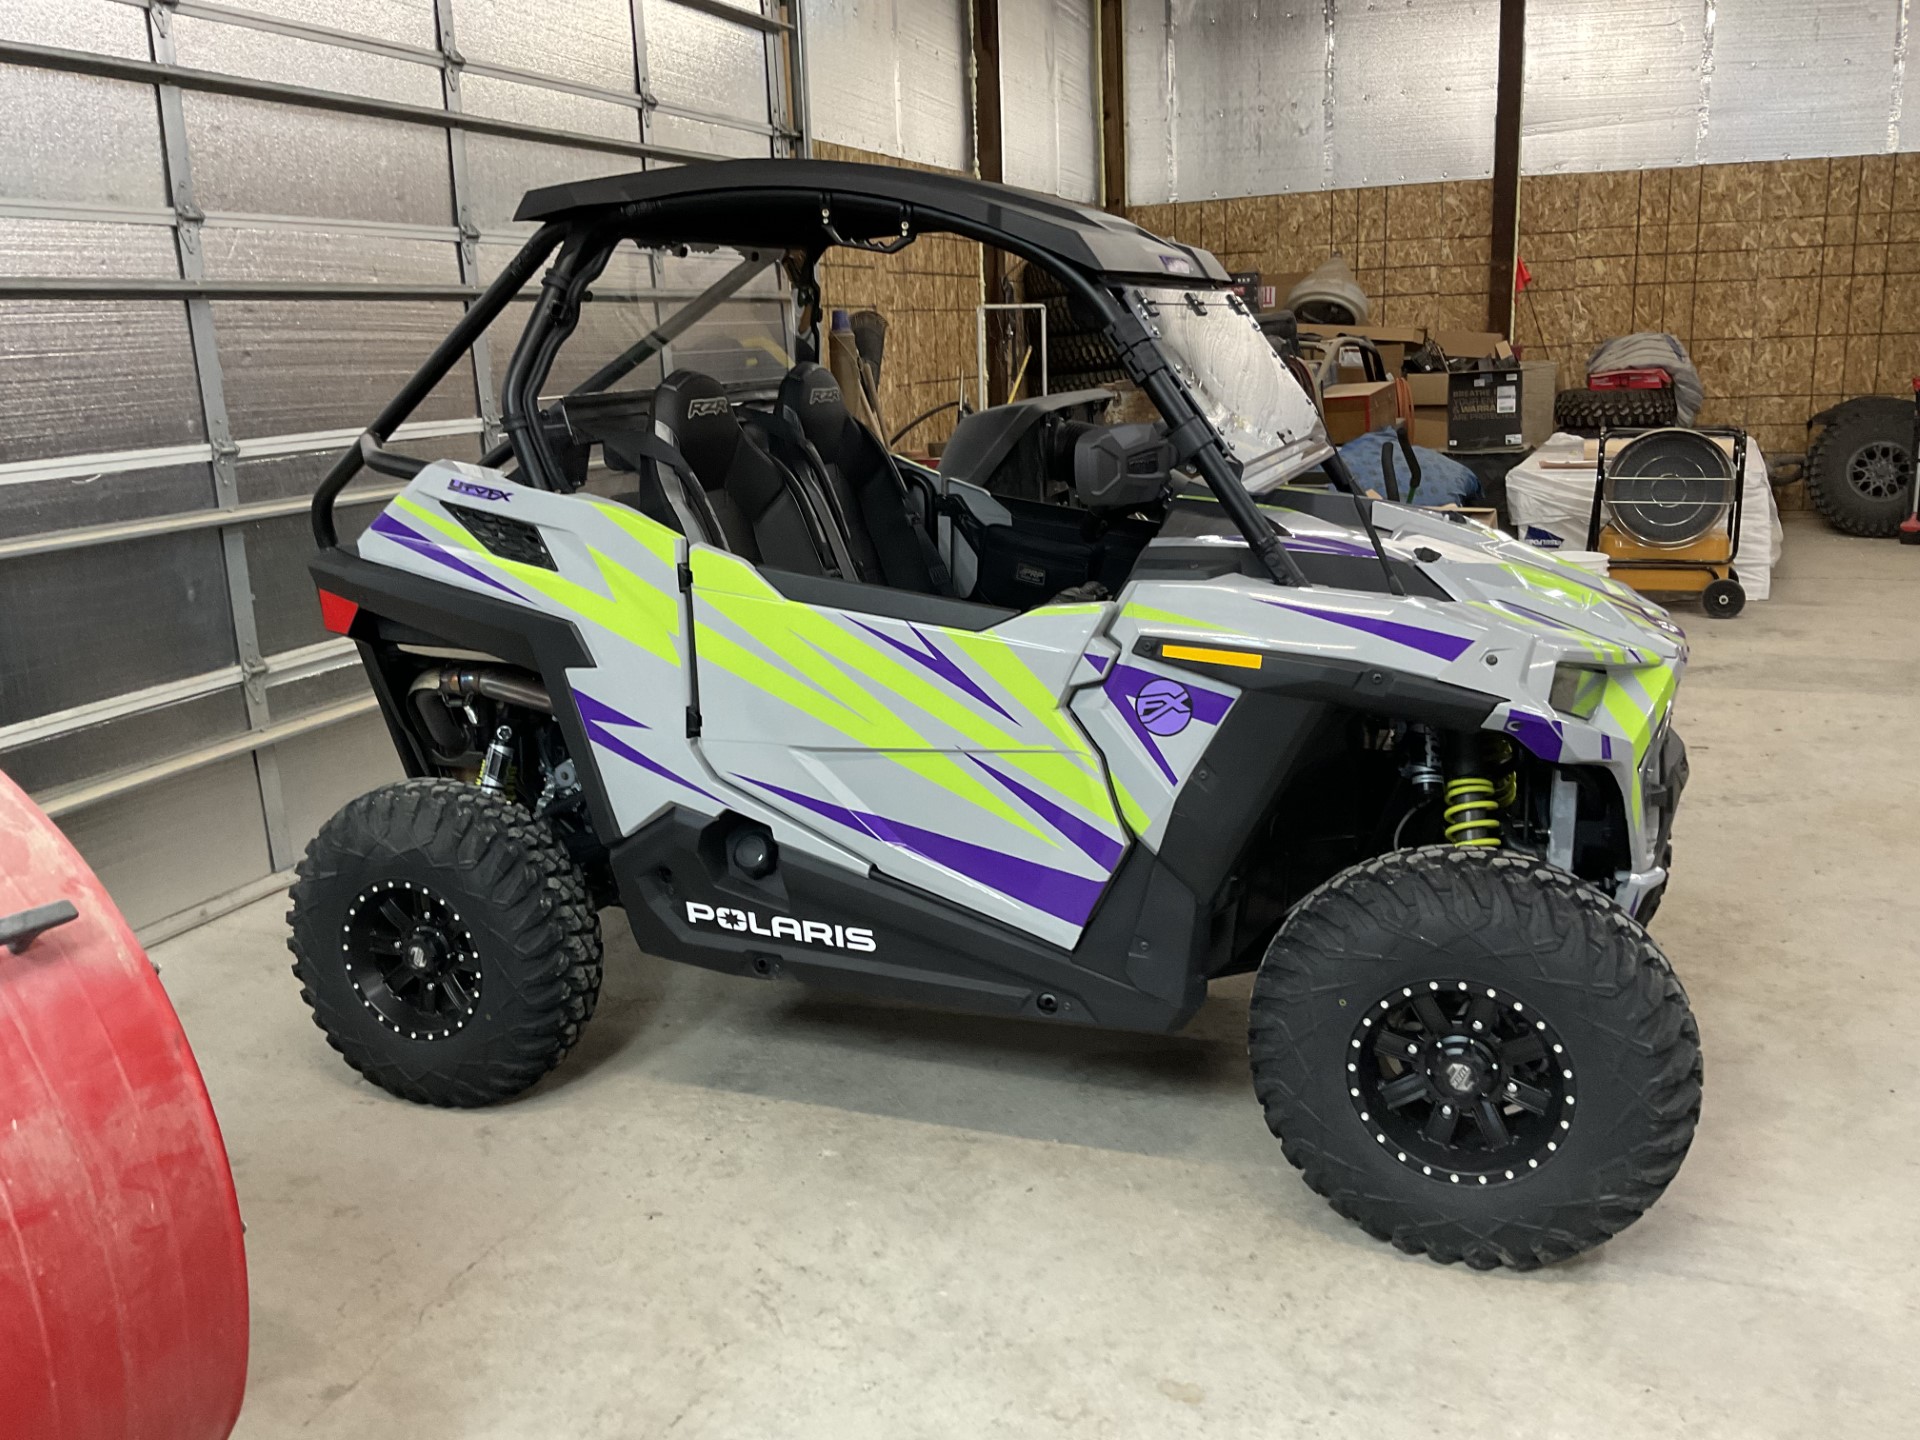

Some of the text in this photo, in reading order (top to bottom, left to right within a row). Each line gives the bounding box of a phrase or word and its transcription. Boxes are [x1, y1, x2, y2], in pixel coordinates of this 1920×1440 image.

[687, 396, 730, 420] RZR
[809, 387, 841, 405] RZR
[685, 901, 877, 952] POLARIS
